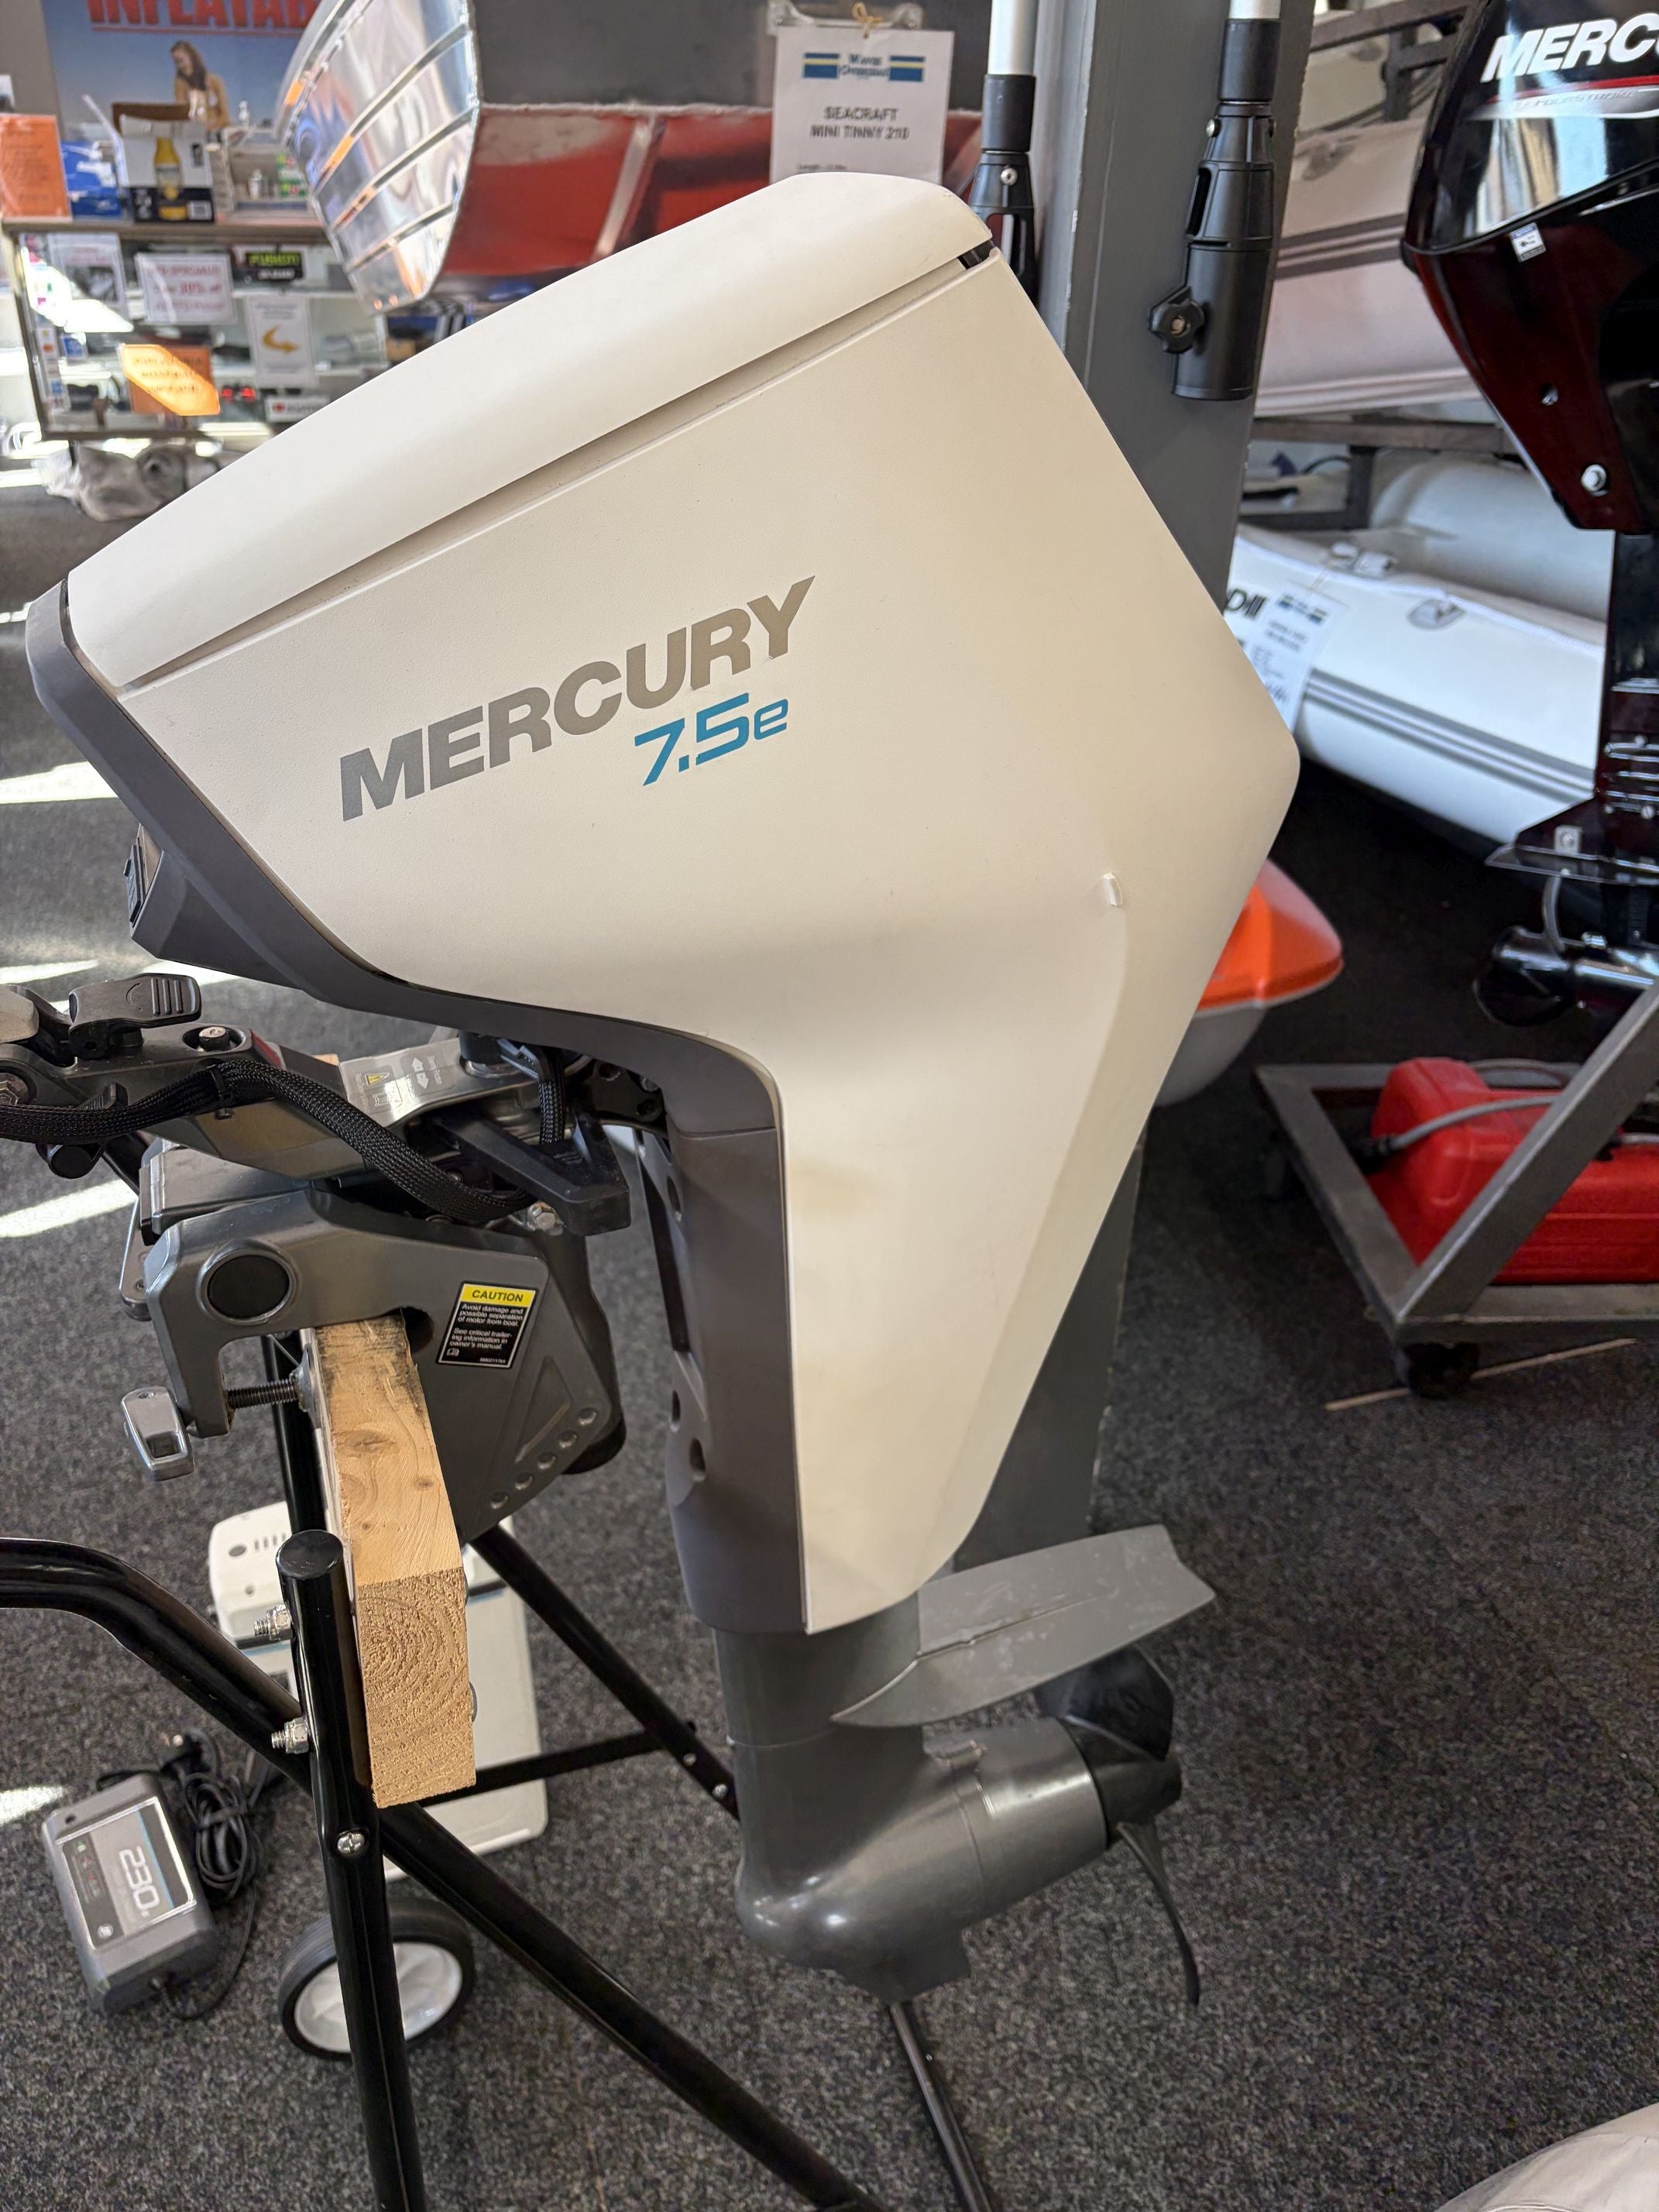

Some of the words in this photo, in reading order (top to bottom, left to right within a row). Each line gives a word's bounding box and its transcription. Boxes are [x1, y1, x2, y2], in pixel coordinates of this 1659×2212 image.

[1480, 12, 1659, 83] MERC
[823, 106, 898, 122] SEACRAFT
[340, 575, 816, 822] MERCURY
[634, 692, 788, 786] 7.5e
[472, 1290, 524, 1303] CAUTION
[459, 1310, 488, 1318] possible
[482, 1305, 510, 1314] damage
[463, 1335, 500, 1344] information
[118, 1846, 160, 1910] 230
